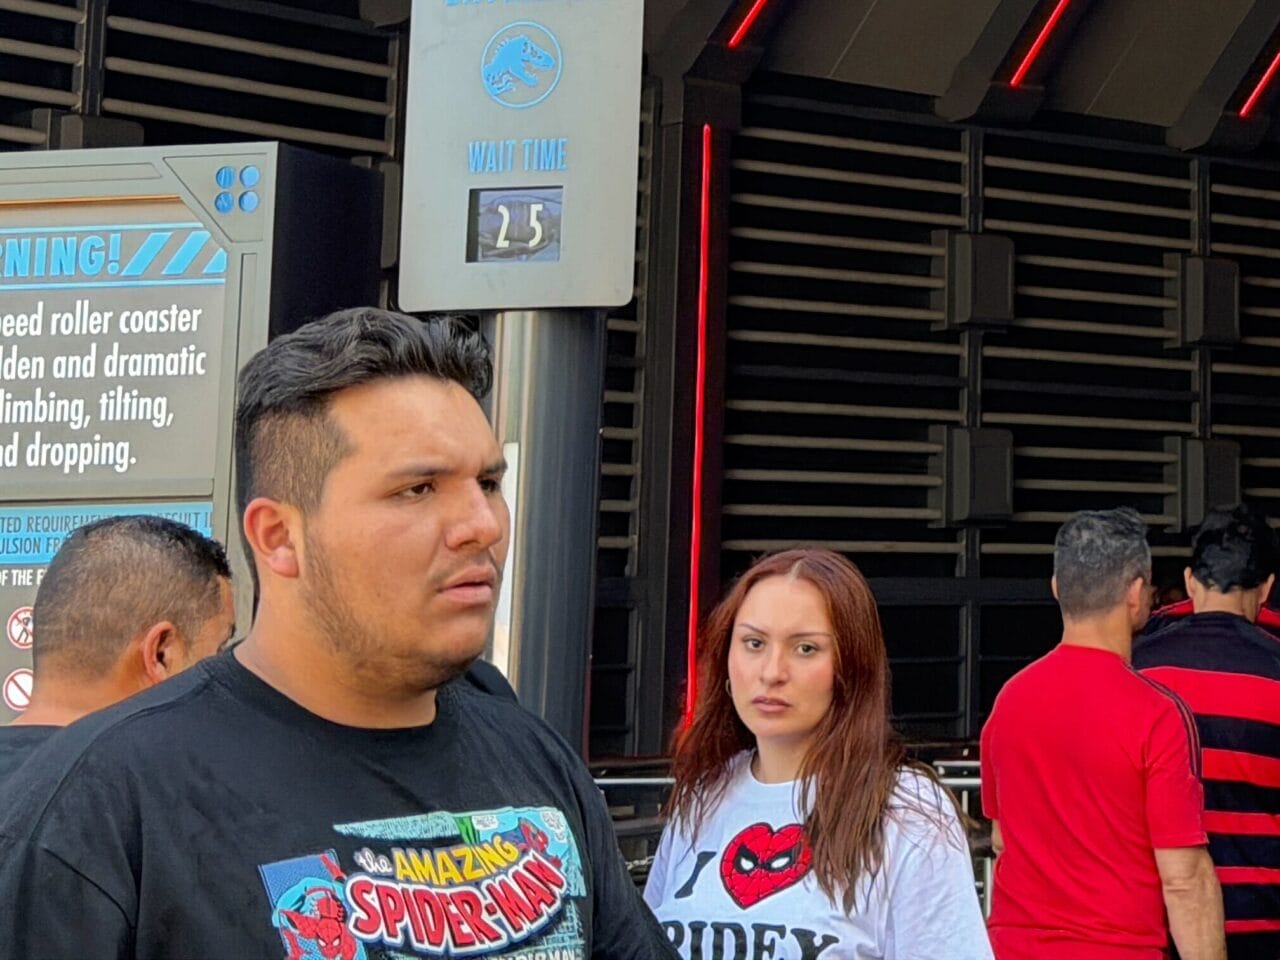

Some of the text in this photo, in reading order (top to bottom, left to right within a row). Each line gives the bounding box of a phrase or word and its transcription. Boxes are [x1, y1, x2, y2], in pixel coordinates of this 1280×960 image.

[468, 137, 568, 174] WAIT TIME
[496, 203, 543, 248] 25
[0, 233, 121, 278] NING!
[0, 299, 203, 337] eed roller coaster
[53, 342, 97, 379] and
[103, 342, 207, 377] dramatic
[99, 385, 174, 428] tilting,
[26, 431, 137, 474] dropping.
[11, 568, 34, 586] THE
[354, 835, 519, 886] the AMAZING
[674, 850, 717, 899] I
[349, 853, 567, 948] SPIDER-MAN
